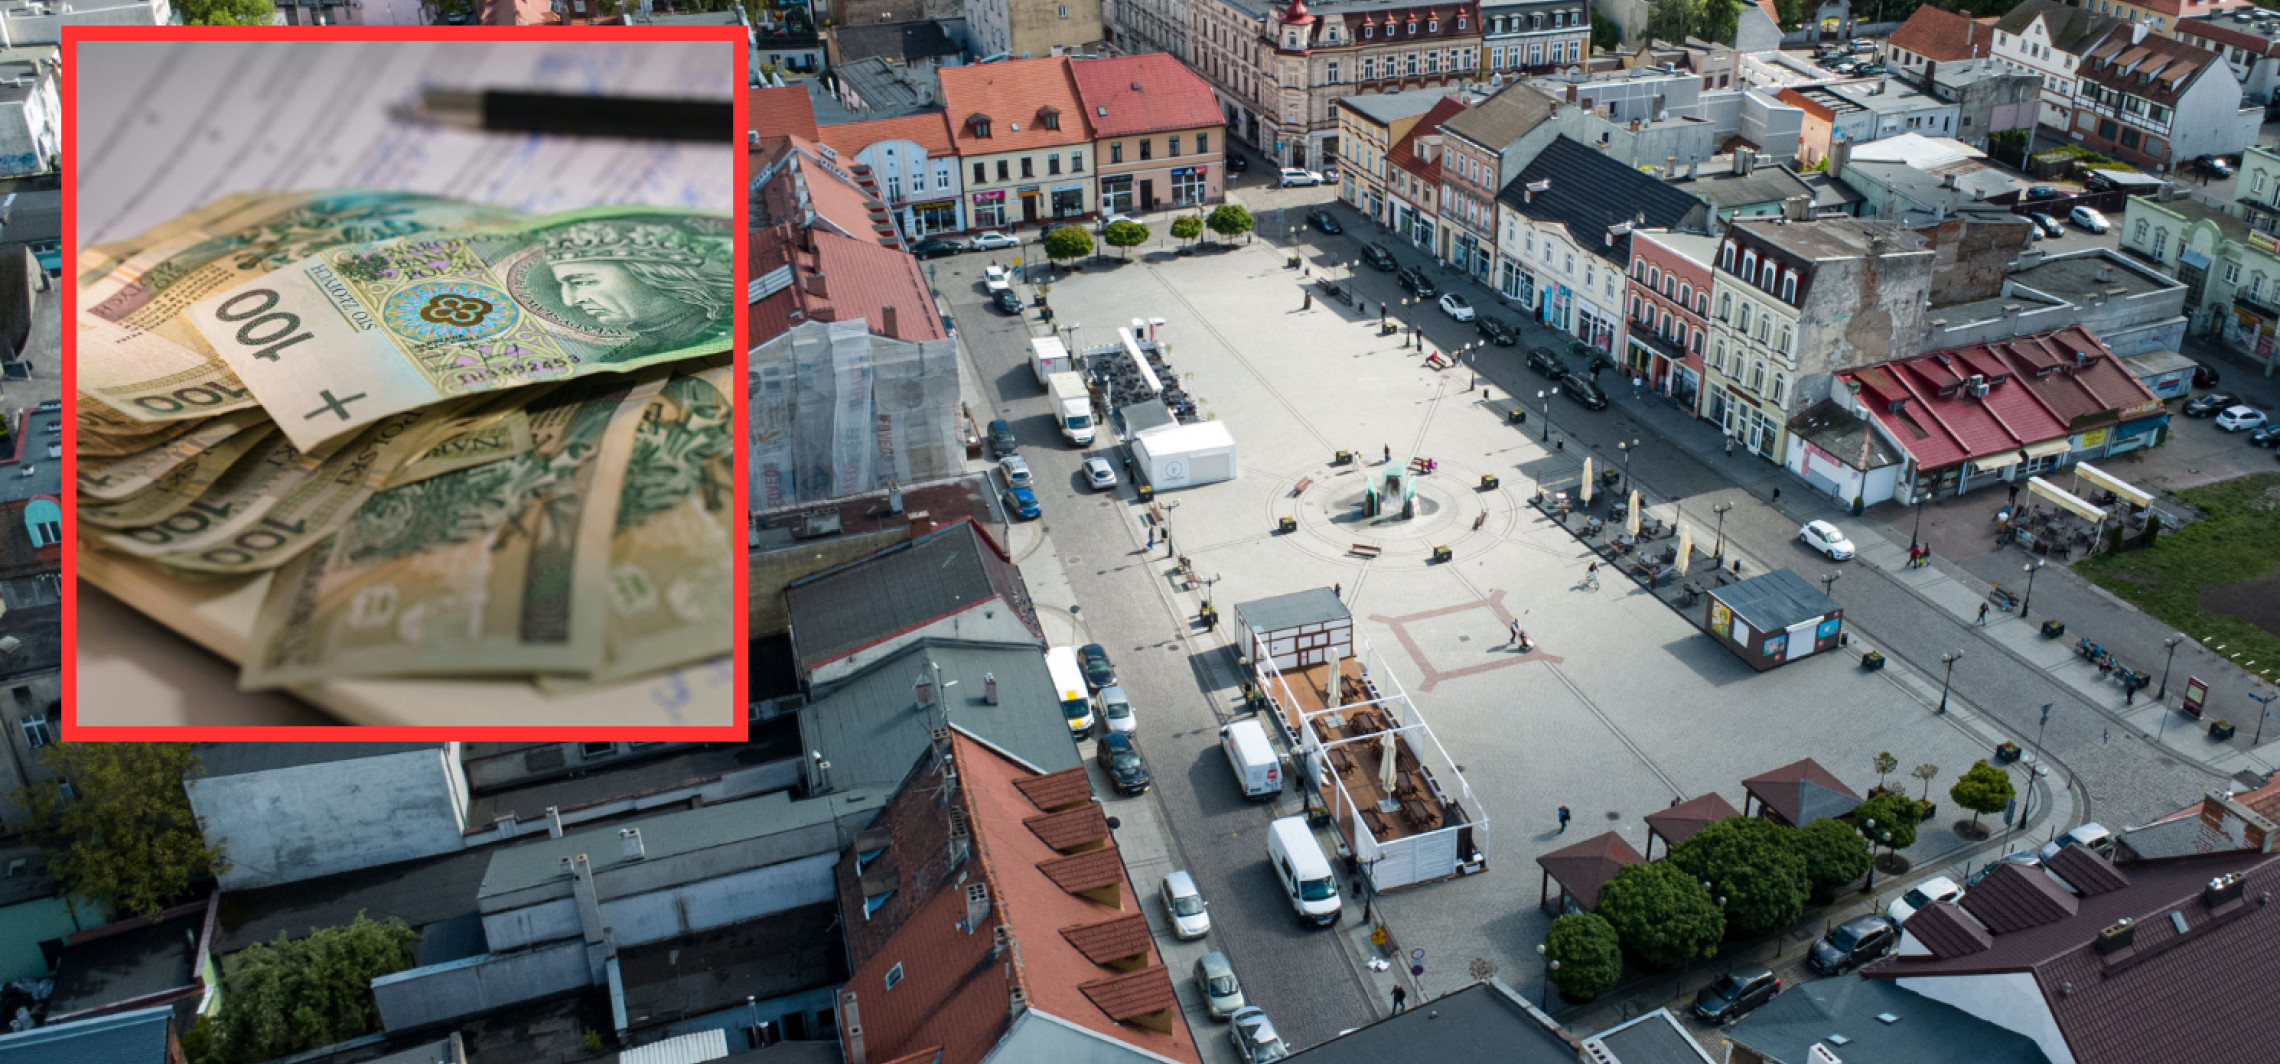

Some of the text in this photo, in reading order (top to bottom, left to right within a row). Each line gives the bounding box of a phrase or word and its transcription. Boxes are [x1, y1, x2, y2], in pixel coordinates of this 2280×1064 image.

[215, 288, 315, 362] 100
[134, 381, 249, 413] 100
[334, 410, 425, 486] POLSKI
[126, 502, 232, 544] 100
[201, 517, 306, 565] 100
